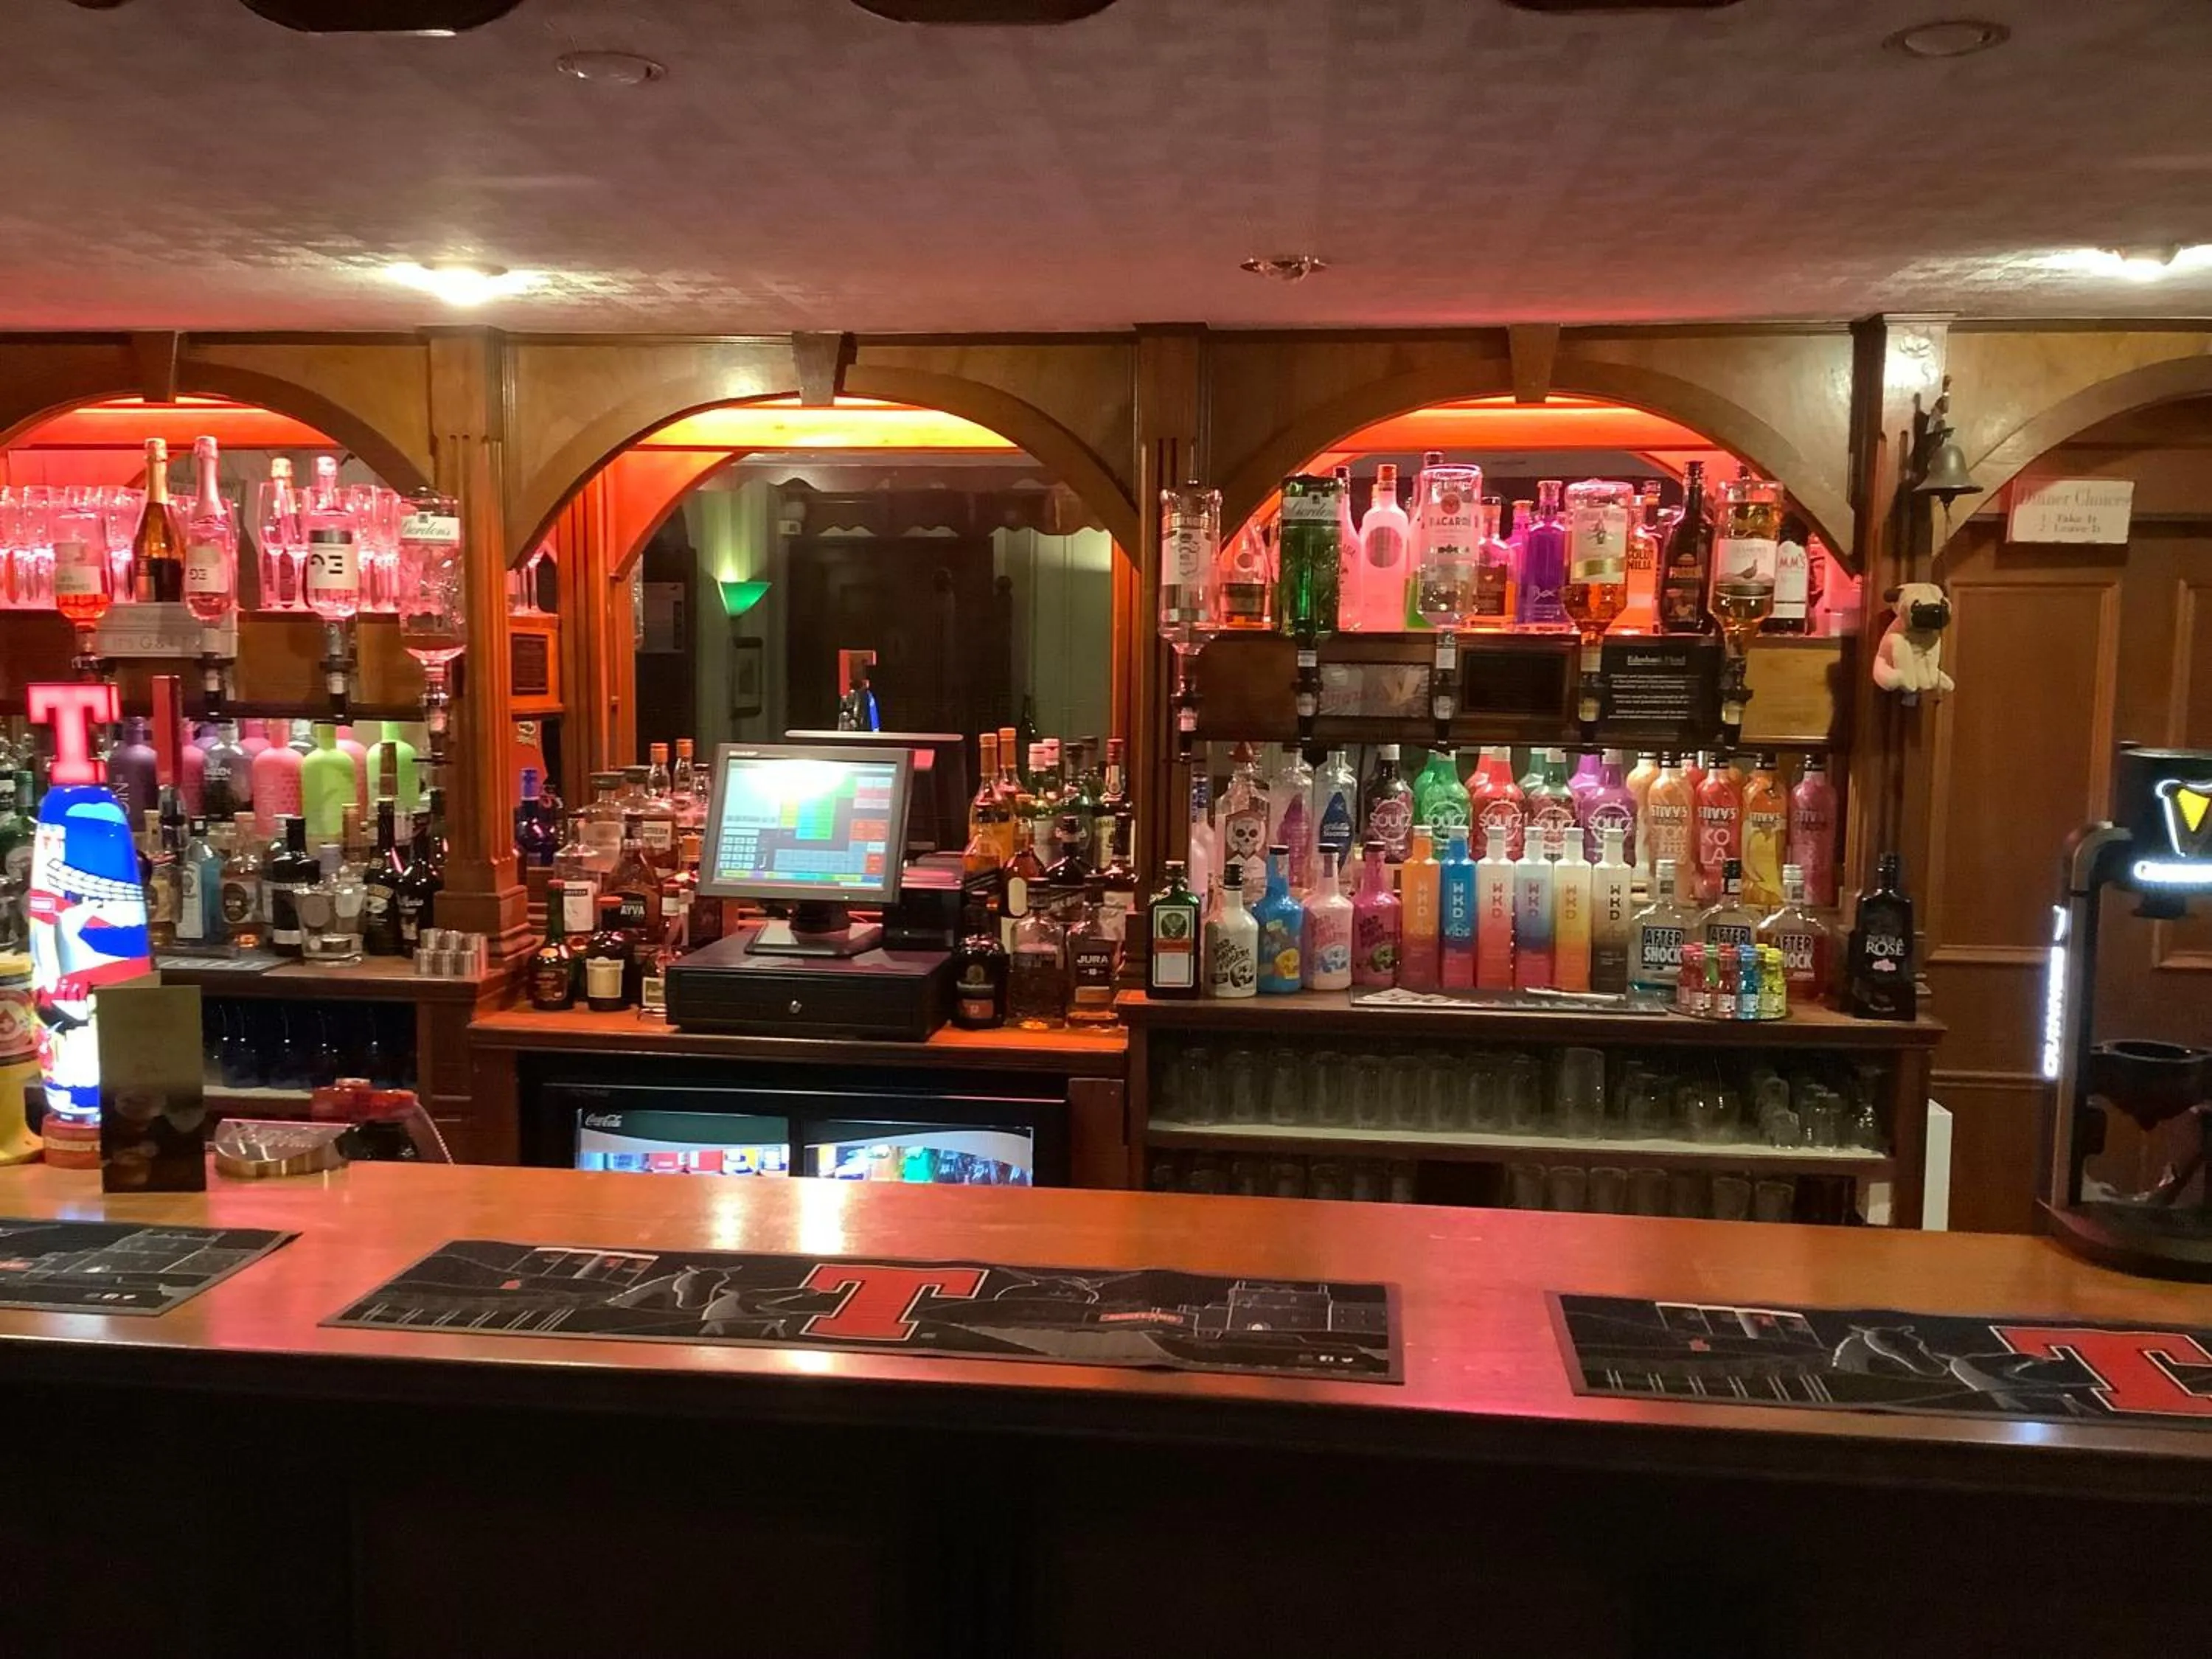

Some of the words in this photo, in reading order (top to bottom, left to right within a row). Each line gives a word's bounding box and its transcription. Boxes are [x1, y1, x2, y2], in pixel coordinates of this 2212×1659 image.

[27, 682, 121, 785] T
[1451, 882, 1464, 919] WKD
[1491, 883, 1503, 919] WKD
[1528, 883, 1540, 917] WKD
[1565, 884, 1577, 920] WKD
[1609, 884, 1621, 921] WKD
[1644, 927, 1684, 946] AFTER
[1710, 925, 1751, 945] AFTER
[1773, 933, 1814, 953] AFTER
[1077, 955, 1109, 964] JURA
[1644, 946, 1683, 963] SHOCK
[1783, 953, 1813, 969] OCK
[585, 1113, 622, 1127] Coca-Cola
[798, 1264, 990, 1341] T
[1989, 1326, 2212, 1417] T
